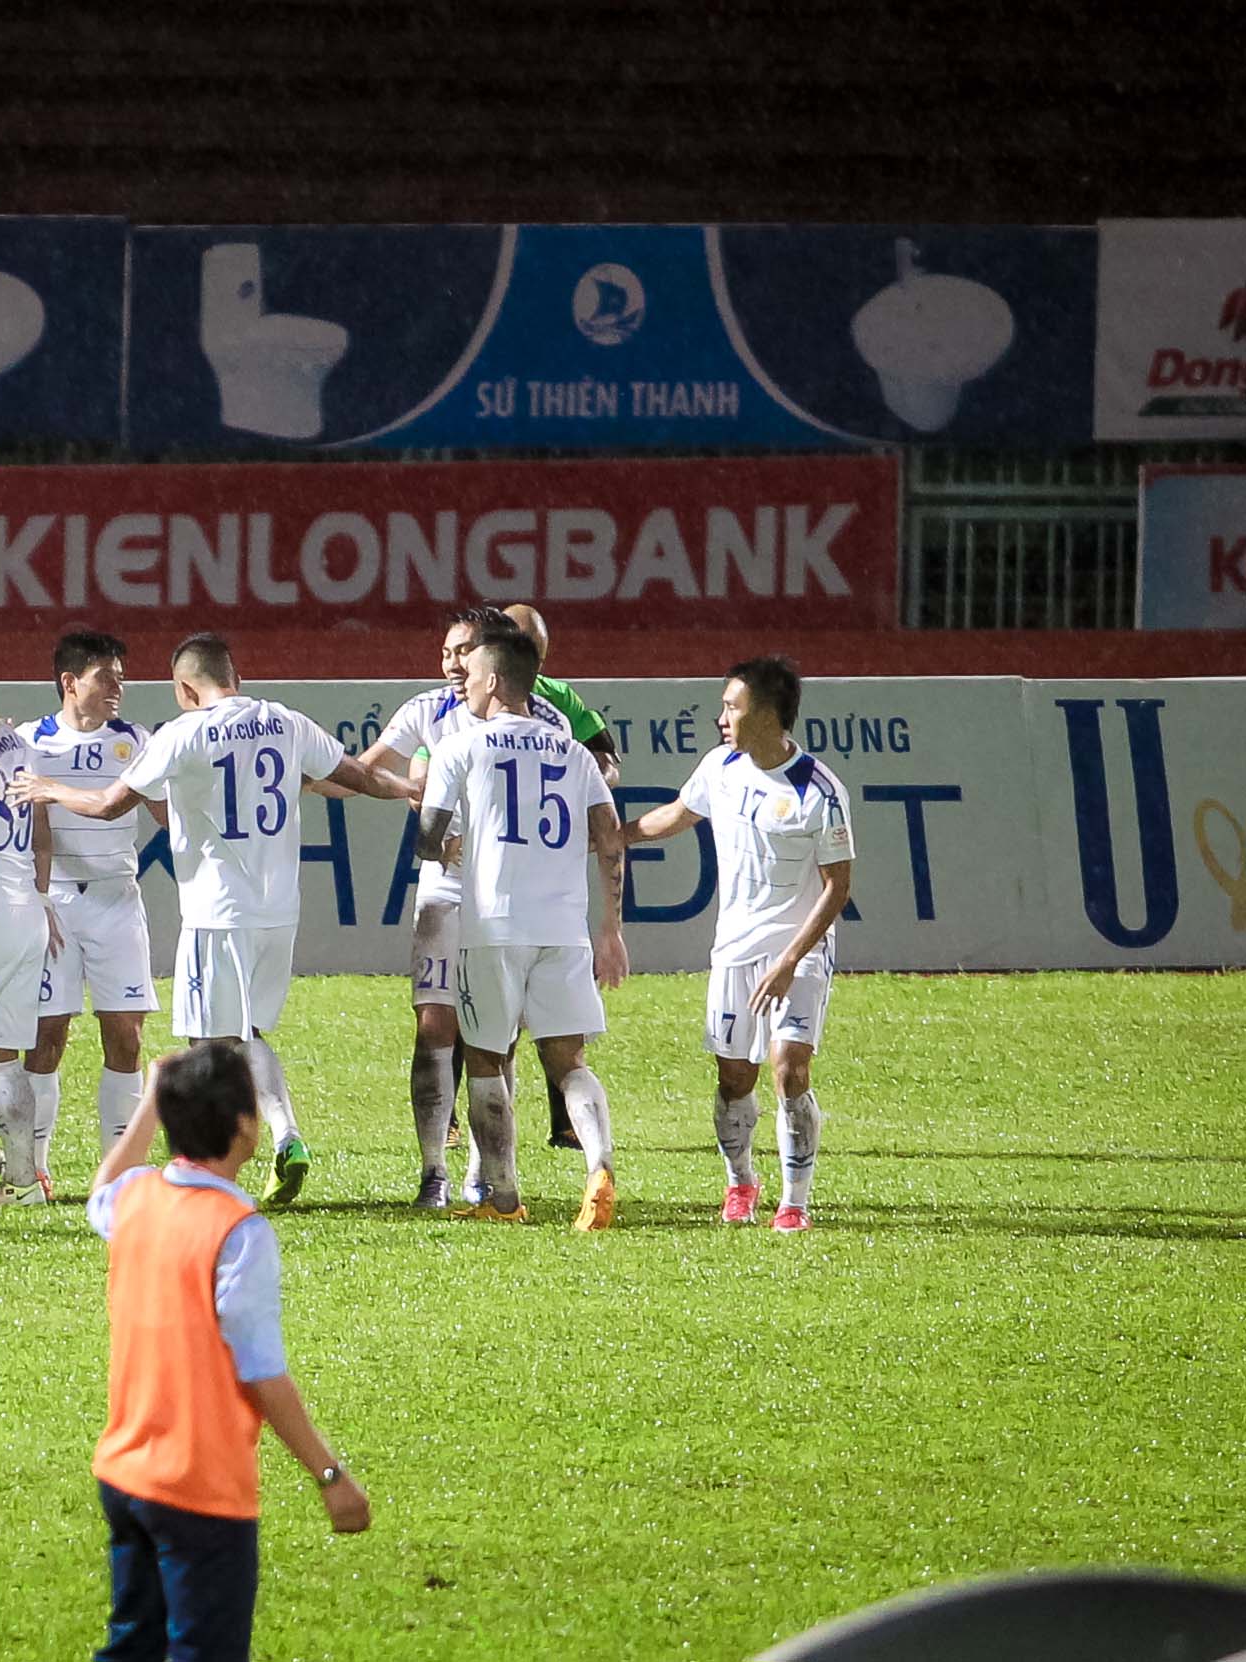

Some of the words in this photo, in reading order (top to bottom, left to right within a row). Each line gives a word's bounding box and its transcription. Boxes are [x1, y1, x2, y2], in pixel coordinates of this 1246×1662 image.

[630, 381, 740, 418] THANH
[70, 742, 103, 771] 18
[805, 712, 911, 760] DỰNG
[212, 746, 287, 840] 13
[494, 758, 572, 850] 15
[417, 956, 449, 991] 21
